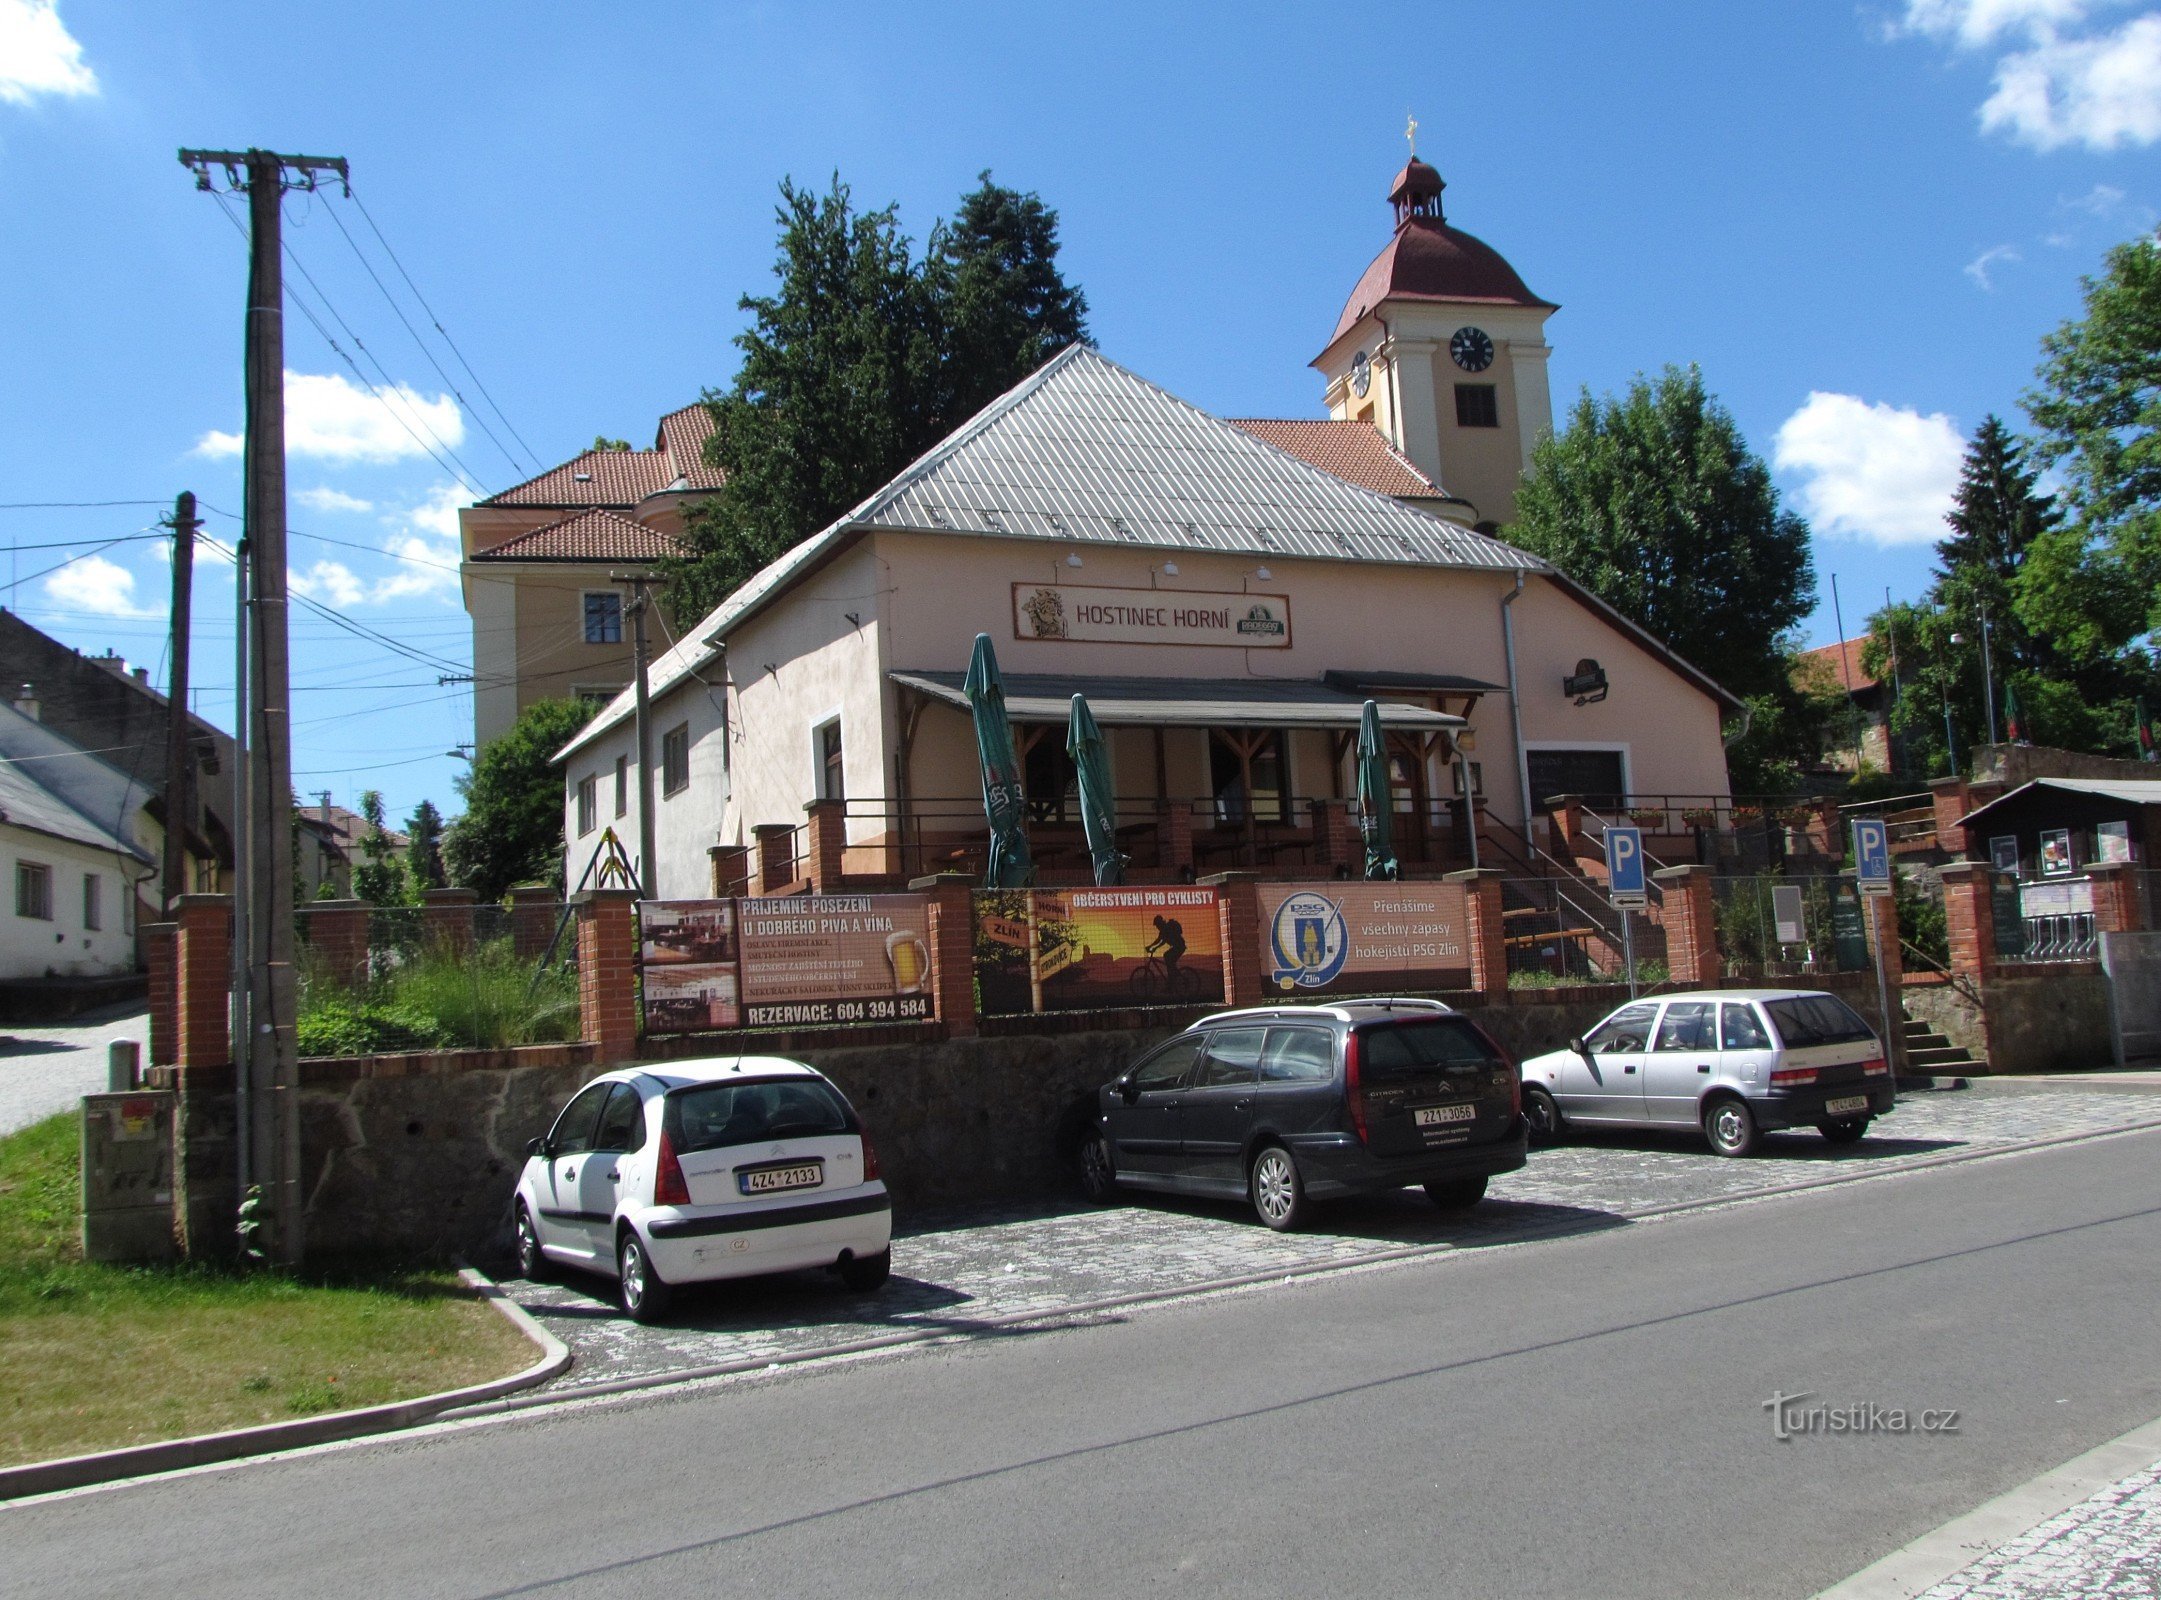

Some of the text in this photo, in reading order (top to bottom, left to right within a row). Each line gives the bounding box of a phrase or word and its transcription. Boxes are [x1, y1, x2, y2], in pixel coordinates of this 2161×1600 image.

[1076, 605, 1230, 629] HOSTINEC HORNÍ
[1614, 835, 1634, 872] P
[1862, 827, 1880, 862] P
[1072, 890, 1214, 908] OBČERSTVENÍ PRO CYKLISTY
[1373, 899, 1435, 913] Přenášíme
[744, 914, 894, 936] U DOBRÉHO PIVA A VÍNA
[994, 923, 1020, 939] ZLÍN
[1361, 921, 1450, 937] všechny zápasy
[1355, 942, 1459, 961] hokejistů PSG Zlín
[1304, 974, 1320, 984] Zlín
[748, 998, 927, 1025] REZERVACE: 604 394 584
[1423, 1106, 1472, 1123] 2Z1 3056
[752, 1168, 816, 1189] 4Z4 2133
[733, 1240, 745, 1249] CZ
